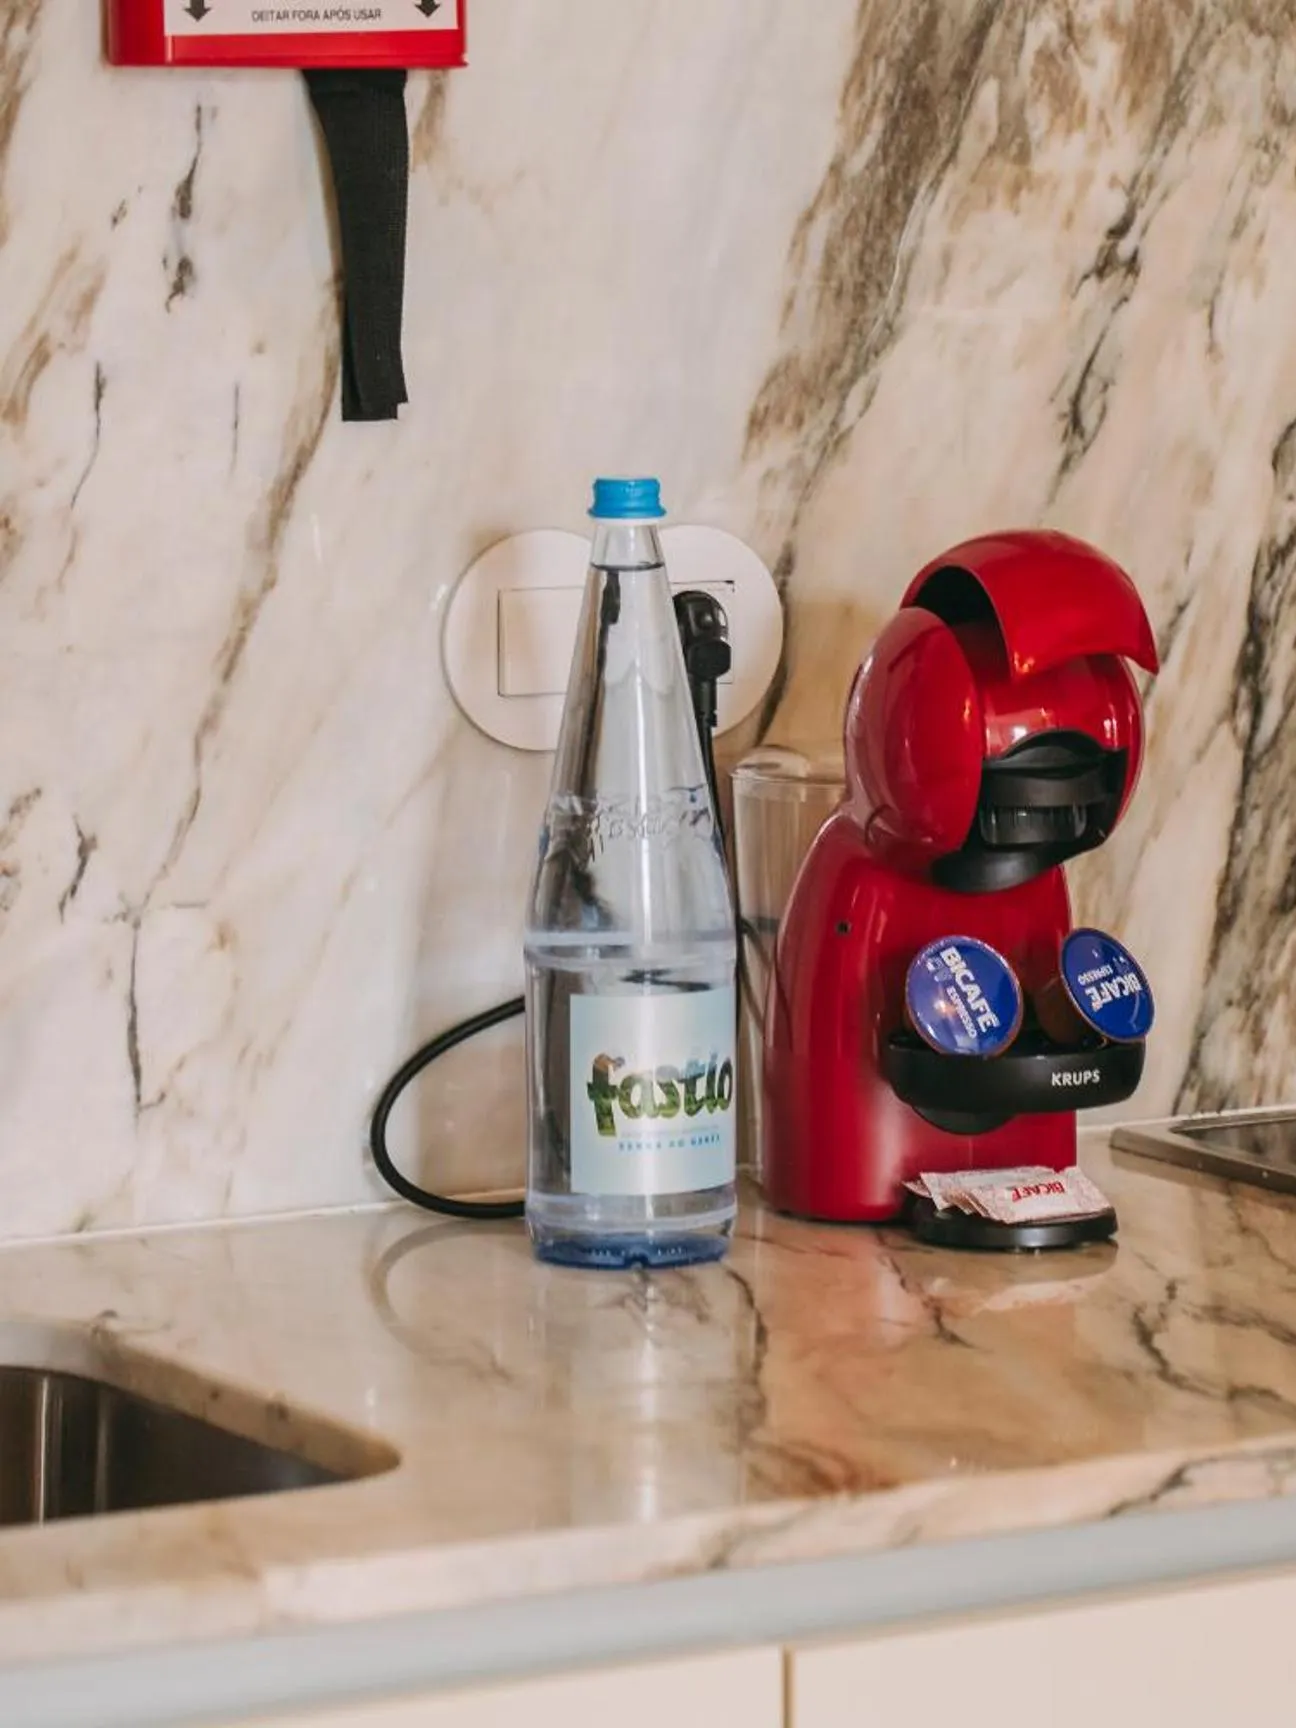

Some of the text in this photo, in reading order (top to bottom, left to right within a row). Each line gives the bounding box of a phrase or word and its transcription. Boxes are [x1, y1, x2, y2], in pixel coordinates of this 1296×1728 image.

[251, 5, 382, 22] DEITAR FORA APÓS USAR
[946, 985, 978, 1038] ESPRESSO
[1051, 1069, 1101, 1087] KRUPS
